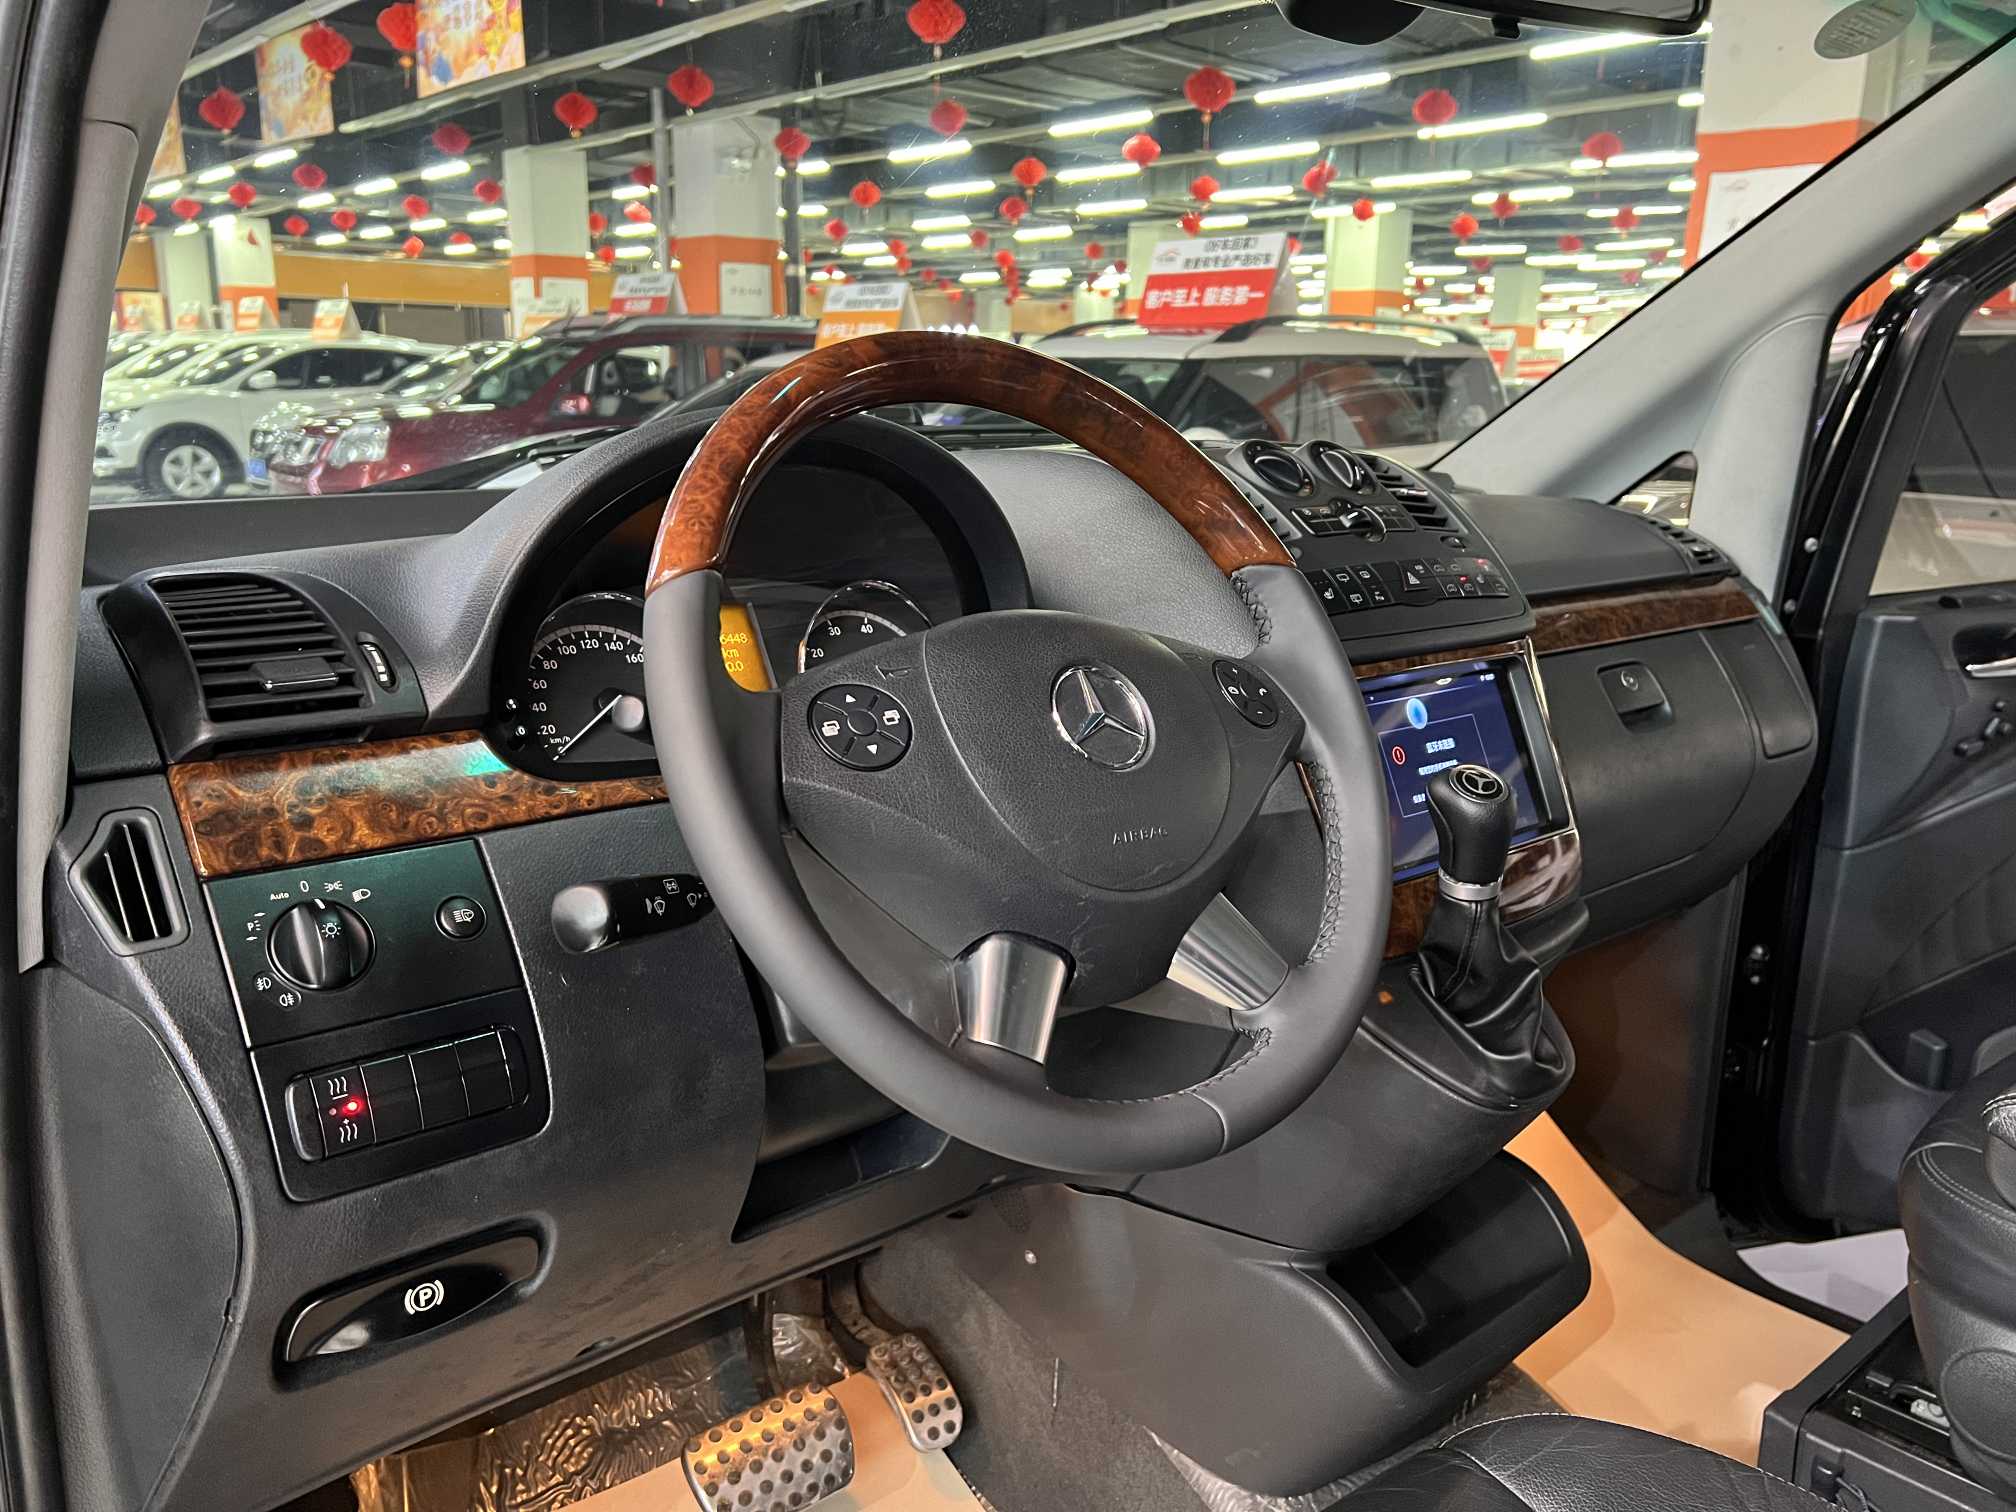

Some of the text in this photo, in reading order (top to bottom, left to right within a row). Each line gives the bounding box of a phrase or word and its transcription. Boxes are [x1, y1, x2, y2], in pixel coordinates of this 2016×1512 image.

[829, 626, 841, 636] 30
[860, 624, 874, 634] 40
[580, 639, 599, 649] 120
[604, 641, 624, 652] 140
[558, 645, 577, 655] 100
[811, 649, 824, 658] 20
[625, 653, 644, 664] 160
[543, 660, 558, 670] 80
[532, 679, 547, 690] 60
[532, 702, 547, 712] 40
[540, 724, 556, 735] 20
[549, 735, 571, 744] km/h
[270, 892, 290, 901] Auto
